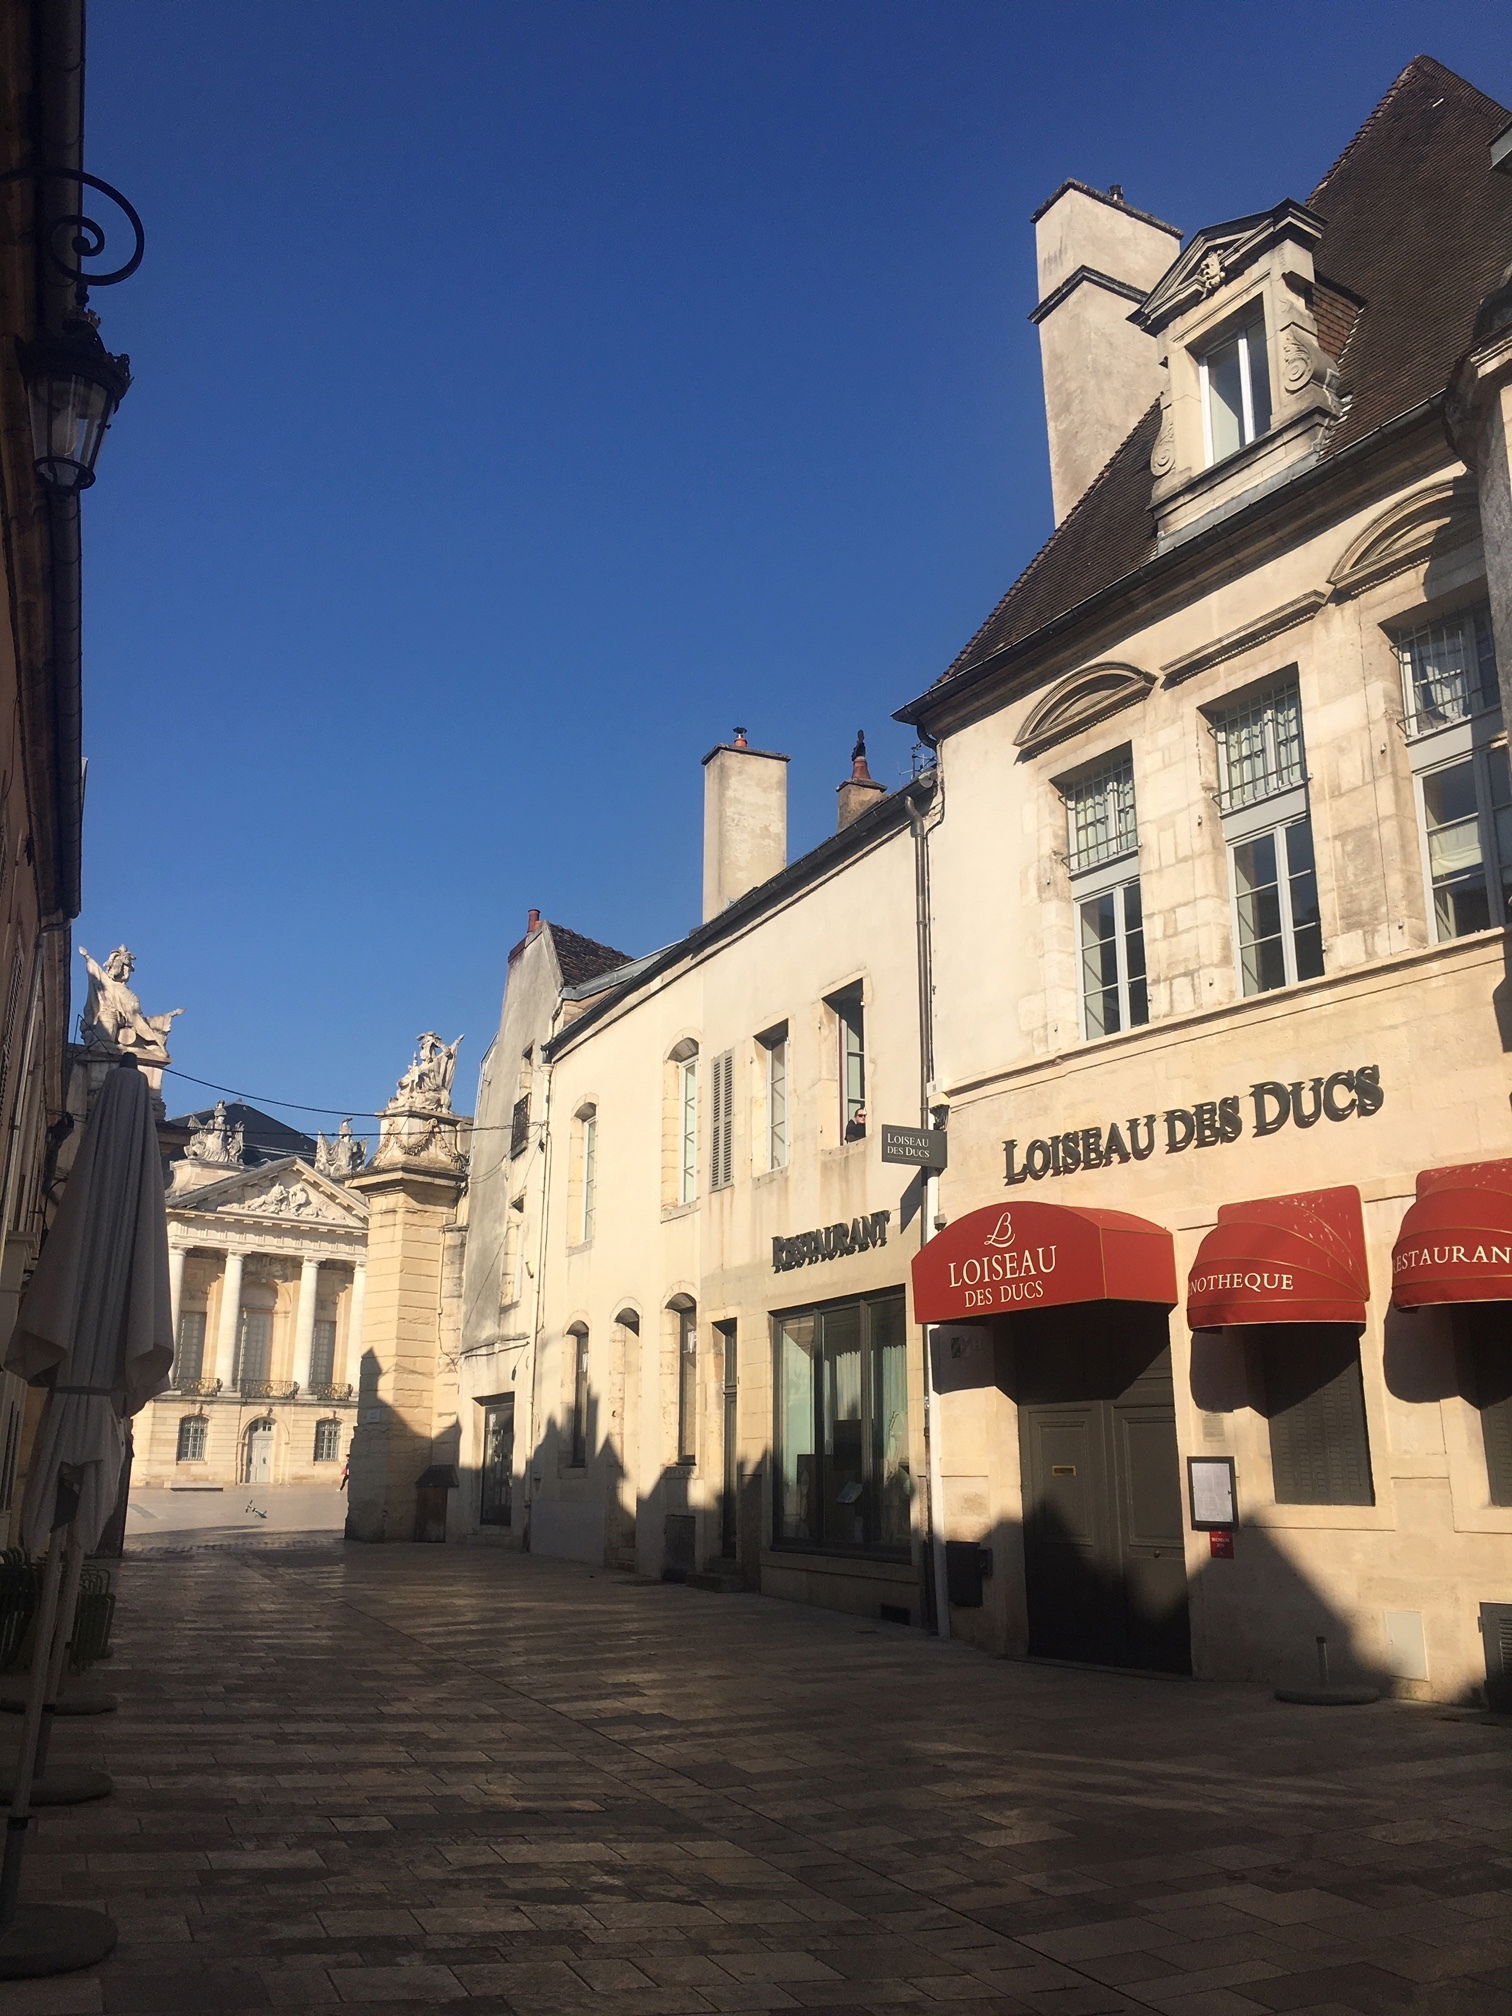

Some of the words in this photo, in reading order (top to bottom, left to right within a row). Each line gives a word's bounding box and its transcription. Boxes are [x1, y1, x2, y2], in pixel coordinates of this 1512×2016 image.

[887, 1133, 929, 1148] LOISEAU
[1002, 1114, 1155, 1185] LOISEAU
[1163, 1096, 1242, 1153] DES
[1249, 1064, 1384, 1138] DUCS
[887, 1145, 904, 1155] DES
[905, 1147, 930, 1158] DUCS
[771, 1210, 891, 1274] RESTAURANT
[948, 1245, 1057, 1288] LOISEAU
[965, 1288, 993, 1308] DES
[1000, 1280, 1044, 1303] DUCS
